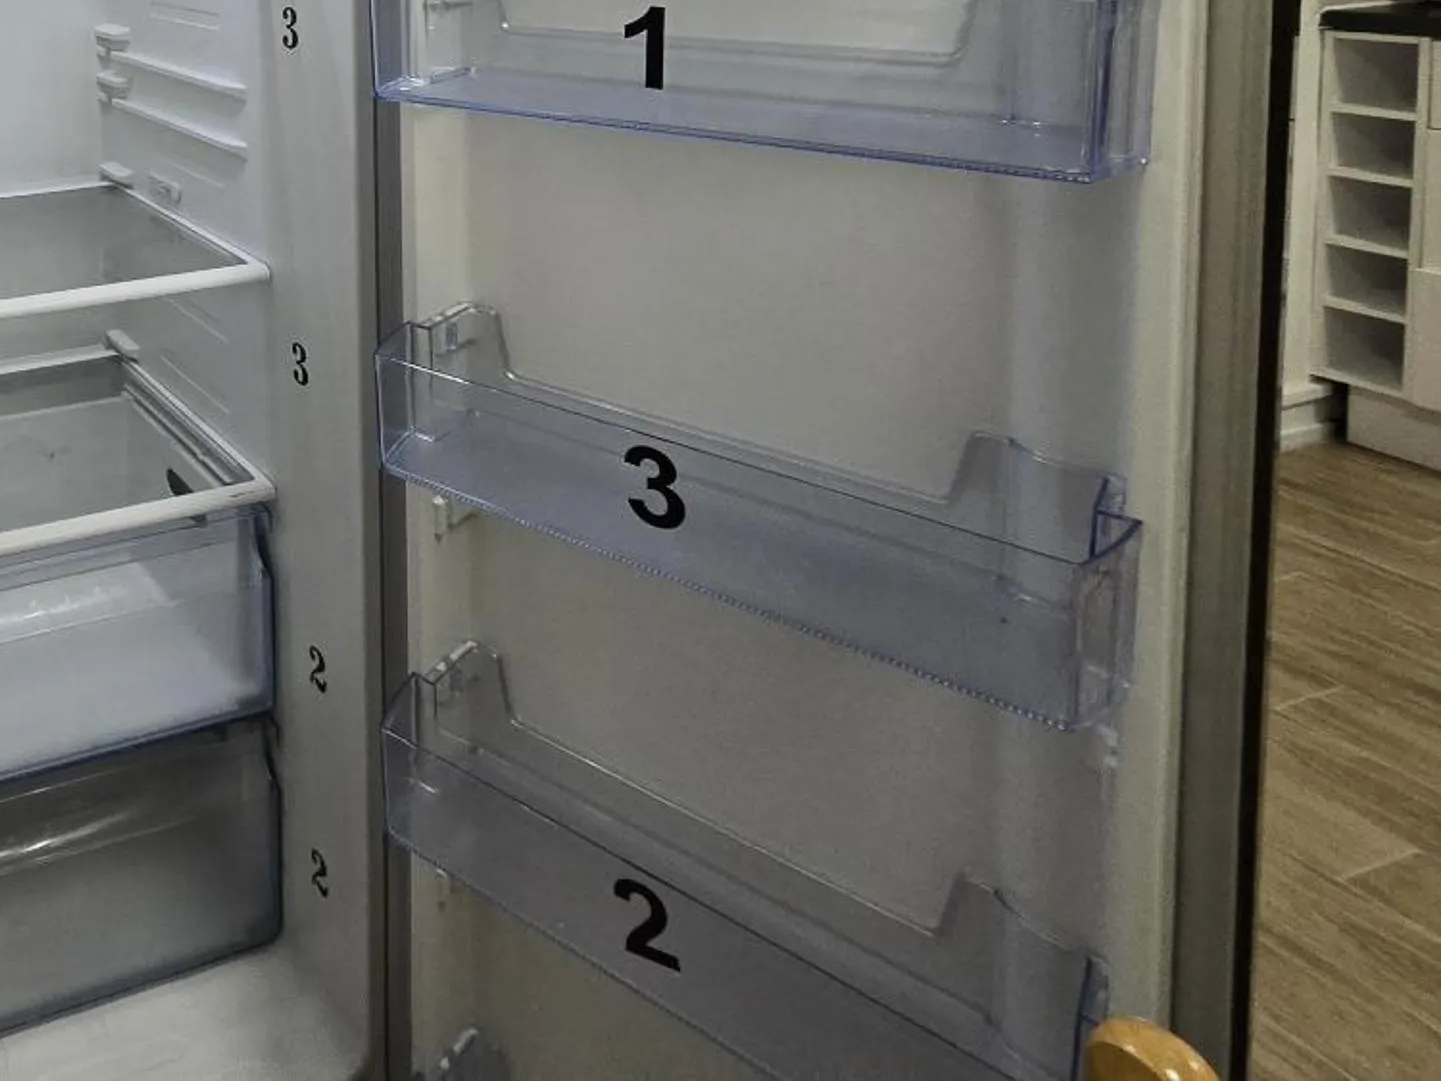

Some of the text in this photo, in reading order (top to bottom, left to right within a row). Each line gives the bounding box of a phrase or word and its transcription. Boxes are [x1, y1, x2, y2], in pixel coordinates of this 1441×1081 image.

[282, 6, 299, 50] 3
[624, 6, 666, 91] 1
[291, 342, 309, 387] 3
[622, 444, 687, 530] 3
[308, 645, 328, 695] 2
[310, 846, 331, 900] 2
[613, 876, 682, 974] 2
